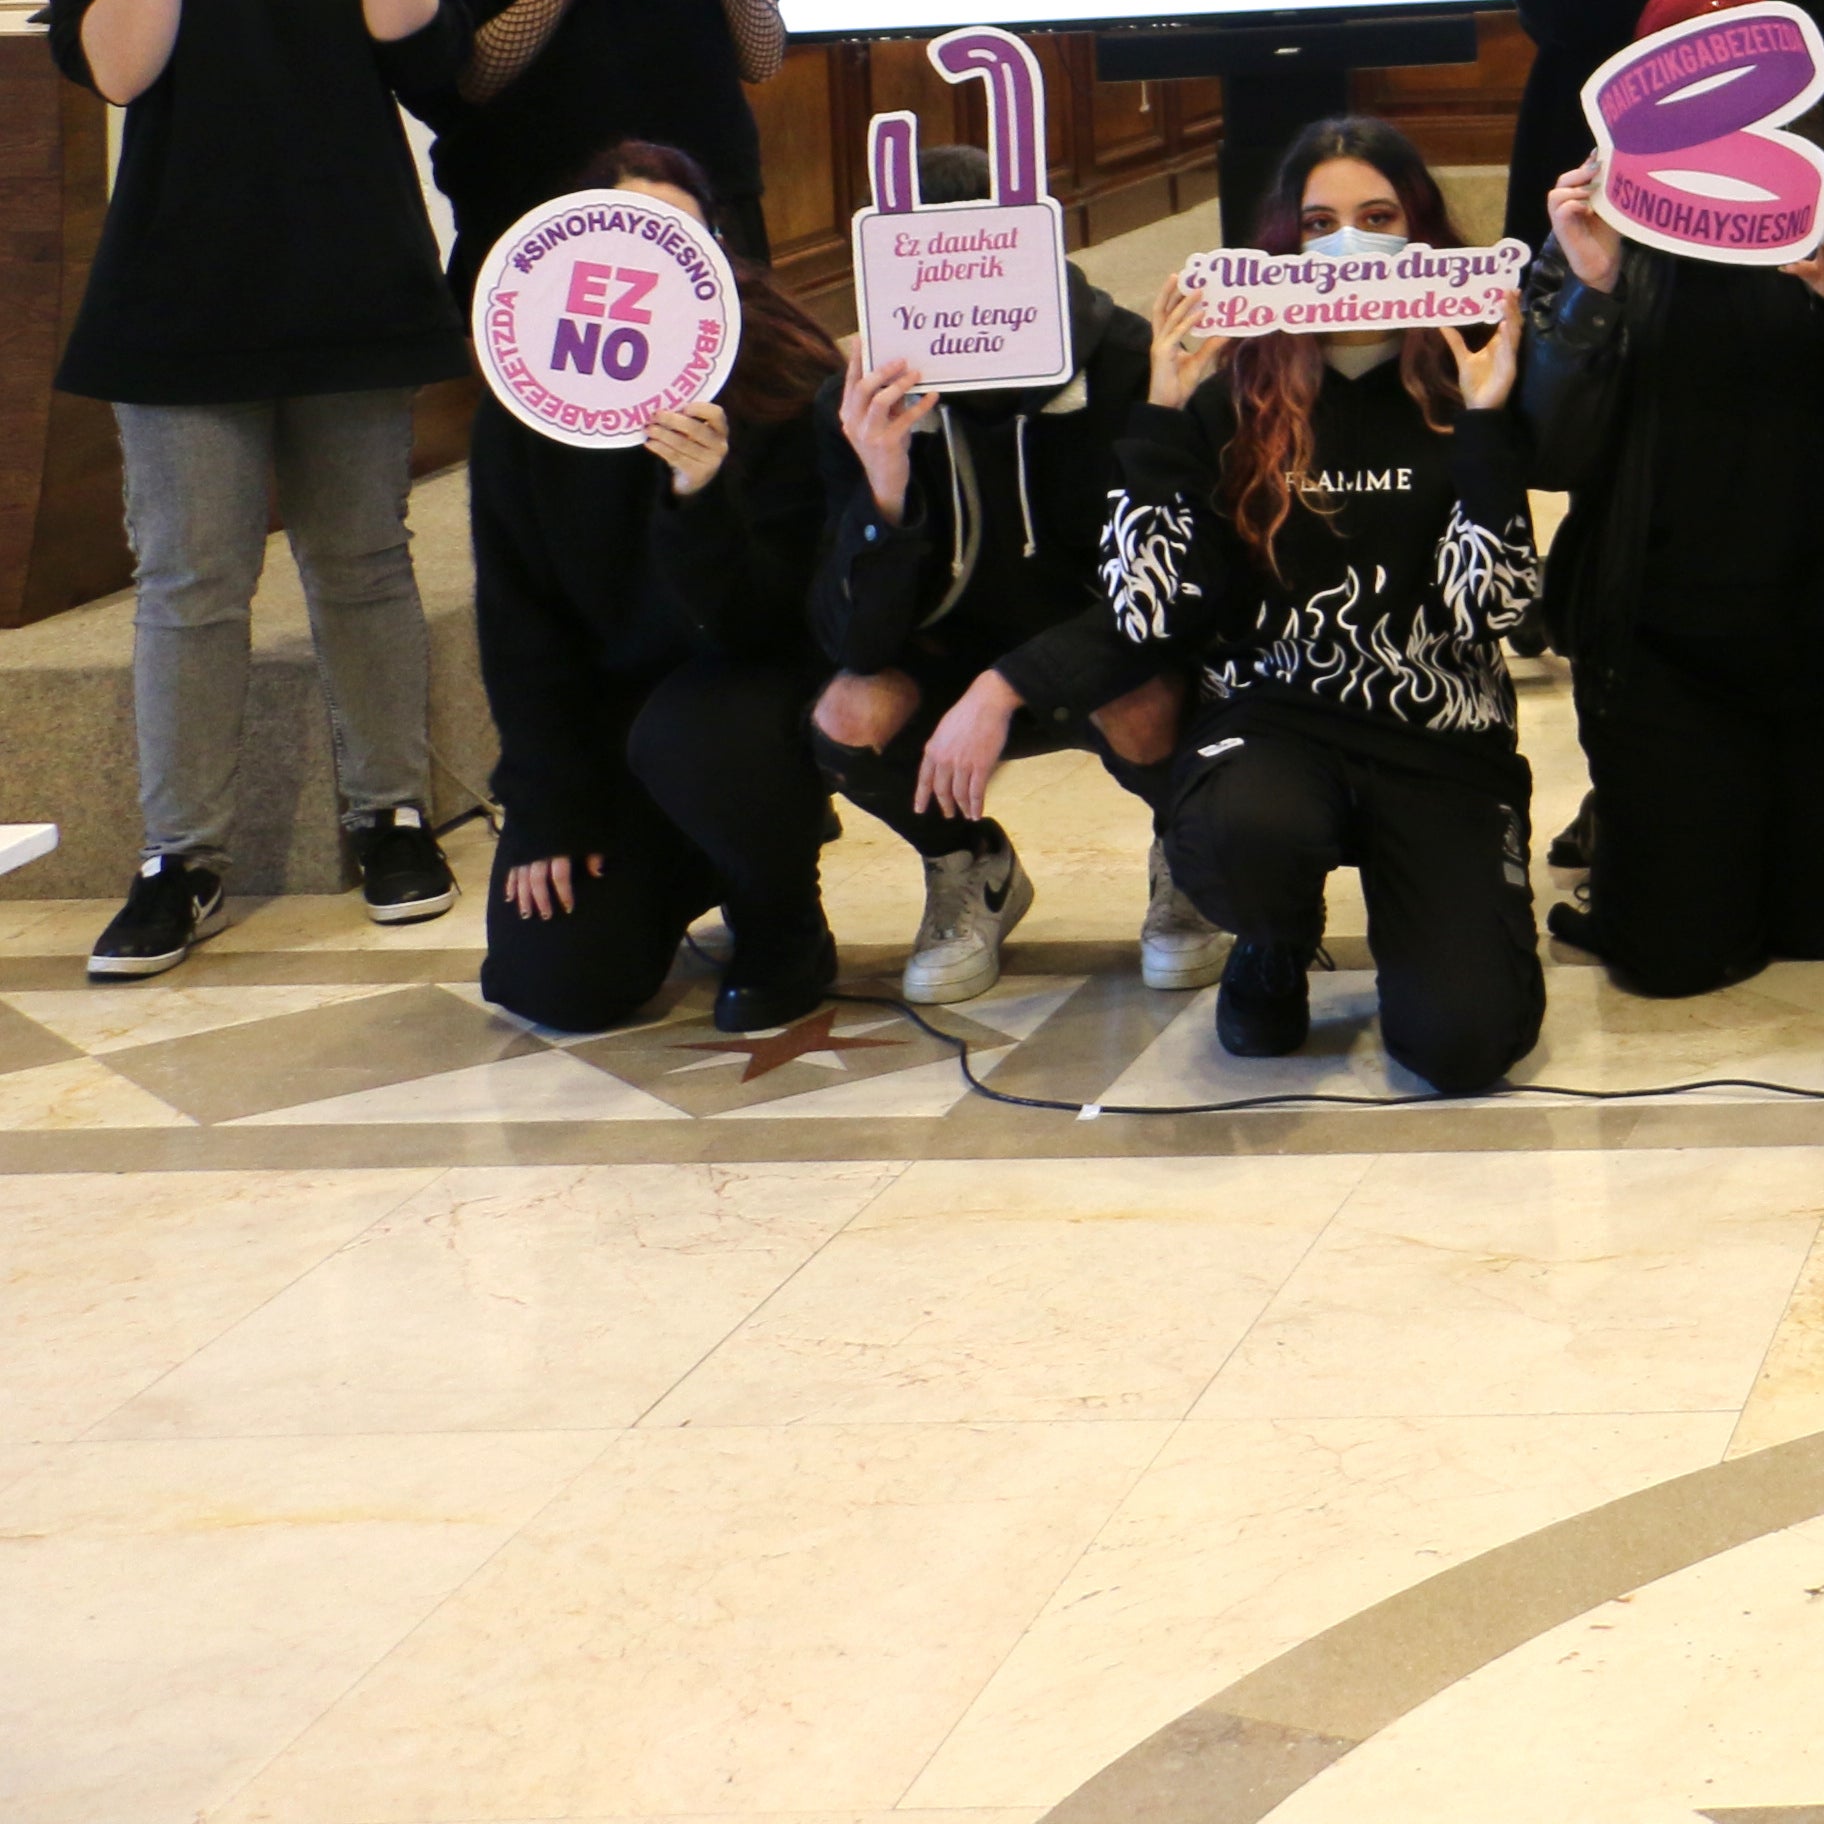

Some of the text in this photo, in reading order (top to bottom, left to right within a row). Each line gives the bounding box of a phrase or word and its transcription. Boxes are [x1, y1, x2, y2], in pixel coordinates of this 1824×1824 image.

[1613, 173, 1810, 243] #SINOHAYSIESNO
[894, 227, 1018, 258] Ez daukat
[911, 255, 1003, 292] jaberik
[1396, 246, 1522, 287] duzu?
[565, 260, 659, 325] EZ
[1284, 287, 1506, 326] entiendes?
[892, 304, 1038, 332] Yo no tengo
[550, 318, 649, 381] NO
[930, 331, 1005, 356] dueño
